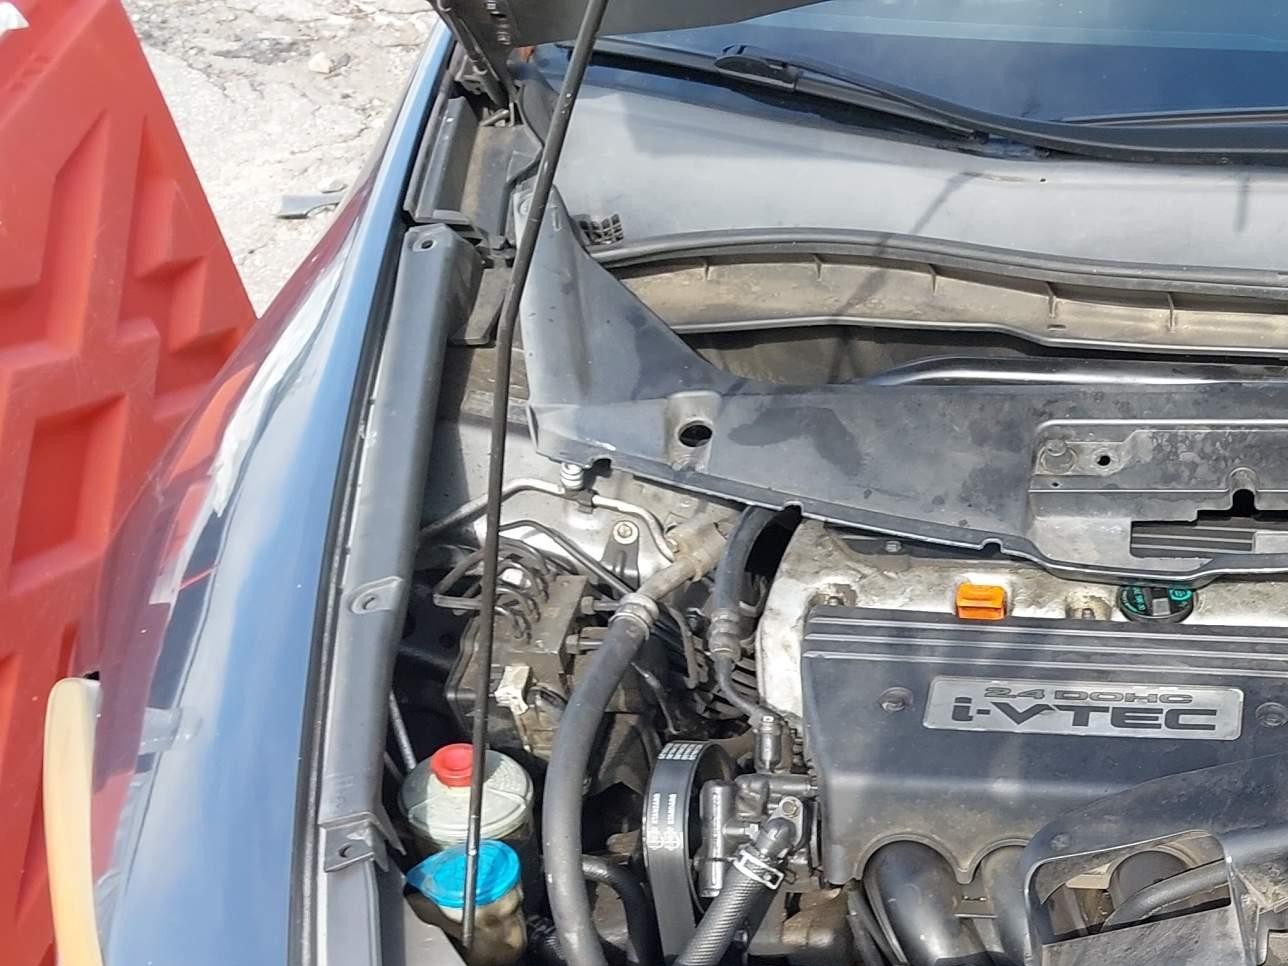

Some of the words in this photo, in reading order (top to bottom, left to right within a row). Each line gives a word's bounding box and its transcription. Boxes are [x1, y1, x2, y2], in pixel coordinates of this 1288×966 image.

[984, 687, 1045, 700] 2.4
[1054, 690, 1193, 704] DOHC
[952, 696, 1217, 731] i-VTEC
